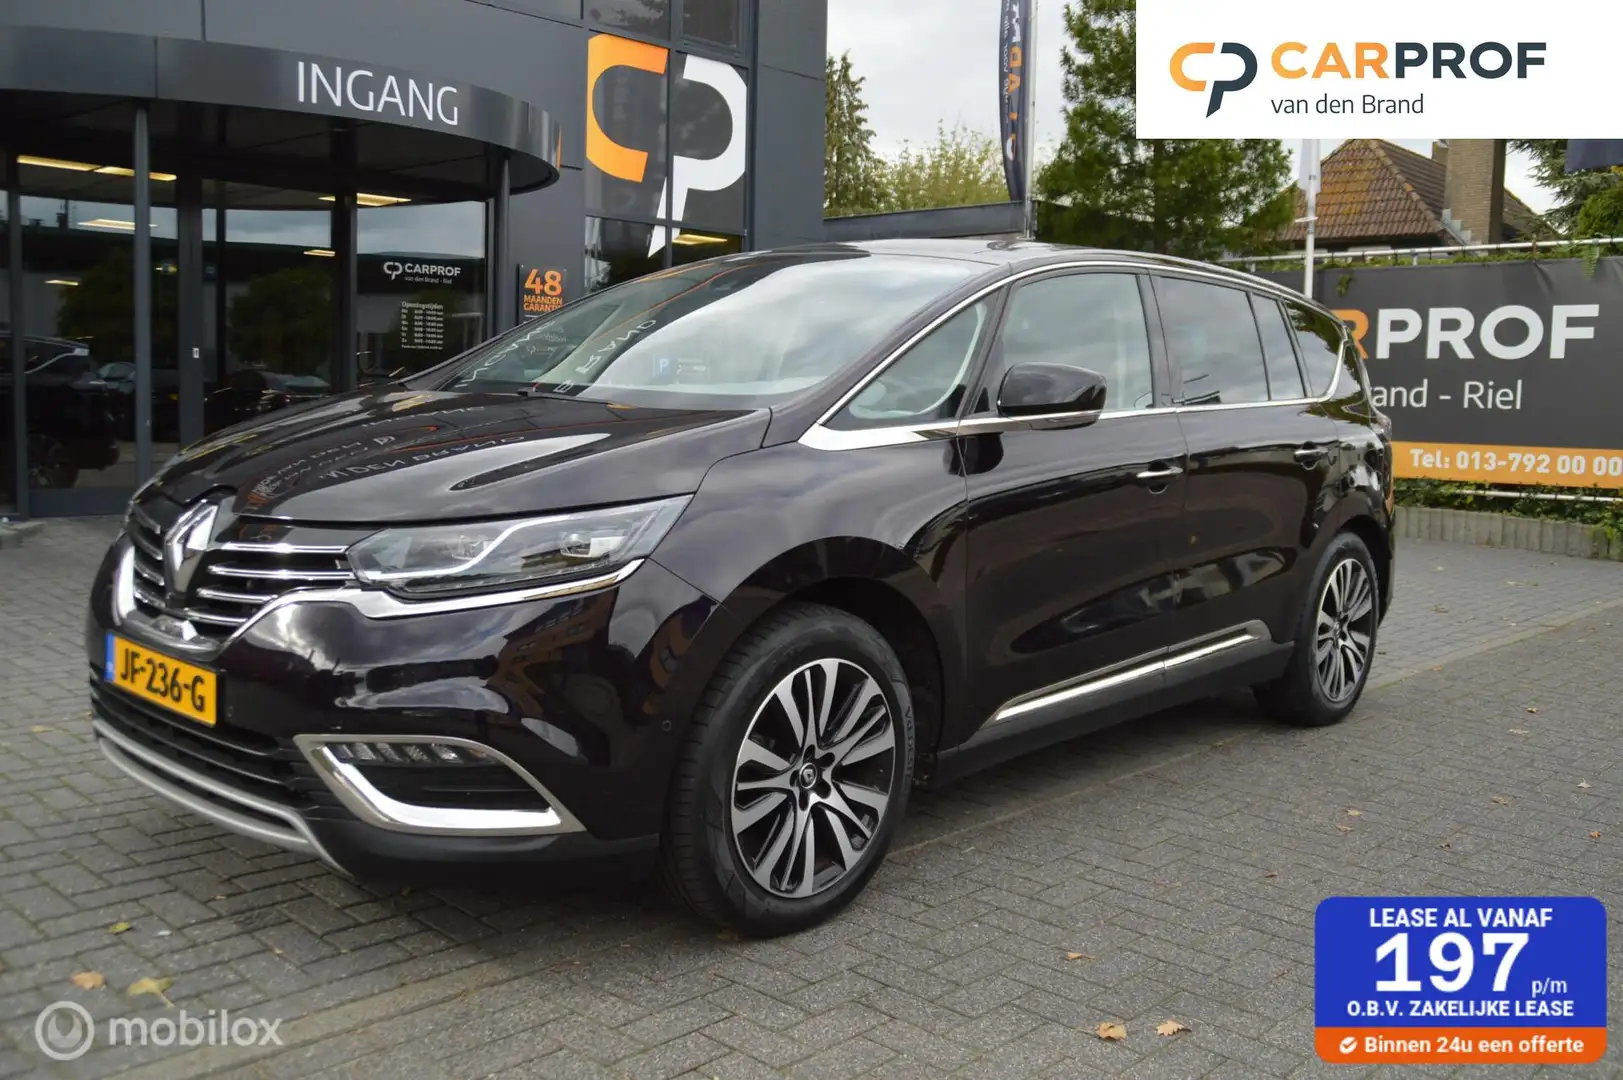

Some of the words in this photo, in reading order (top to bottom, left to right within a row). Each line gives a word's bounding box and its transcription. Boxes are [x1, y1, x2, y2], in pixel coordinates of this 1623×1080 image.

[297, 60, 459, 126] INGANG
[404, 262, 462, 277] CARPROF
[524, 268, 562, 295] 48
[523, 294, 563, 305] MAANDEN
[1463, 379, 1523, 410] Riel
[1409, 448, 1450, 469] Tel:
[1456, 451, 1550, 474] 013-792
[1557, 455, 1585, 475] 00
[1592, 456, 1623, 477] 00
[120, 648, 206, 713] JF-236-G
